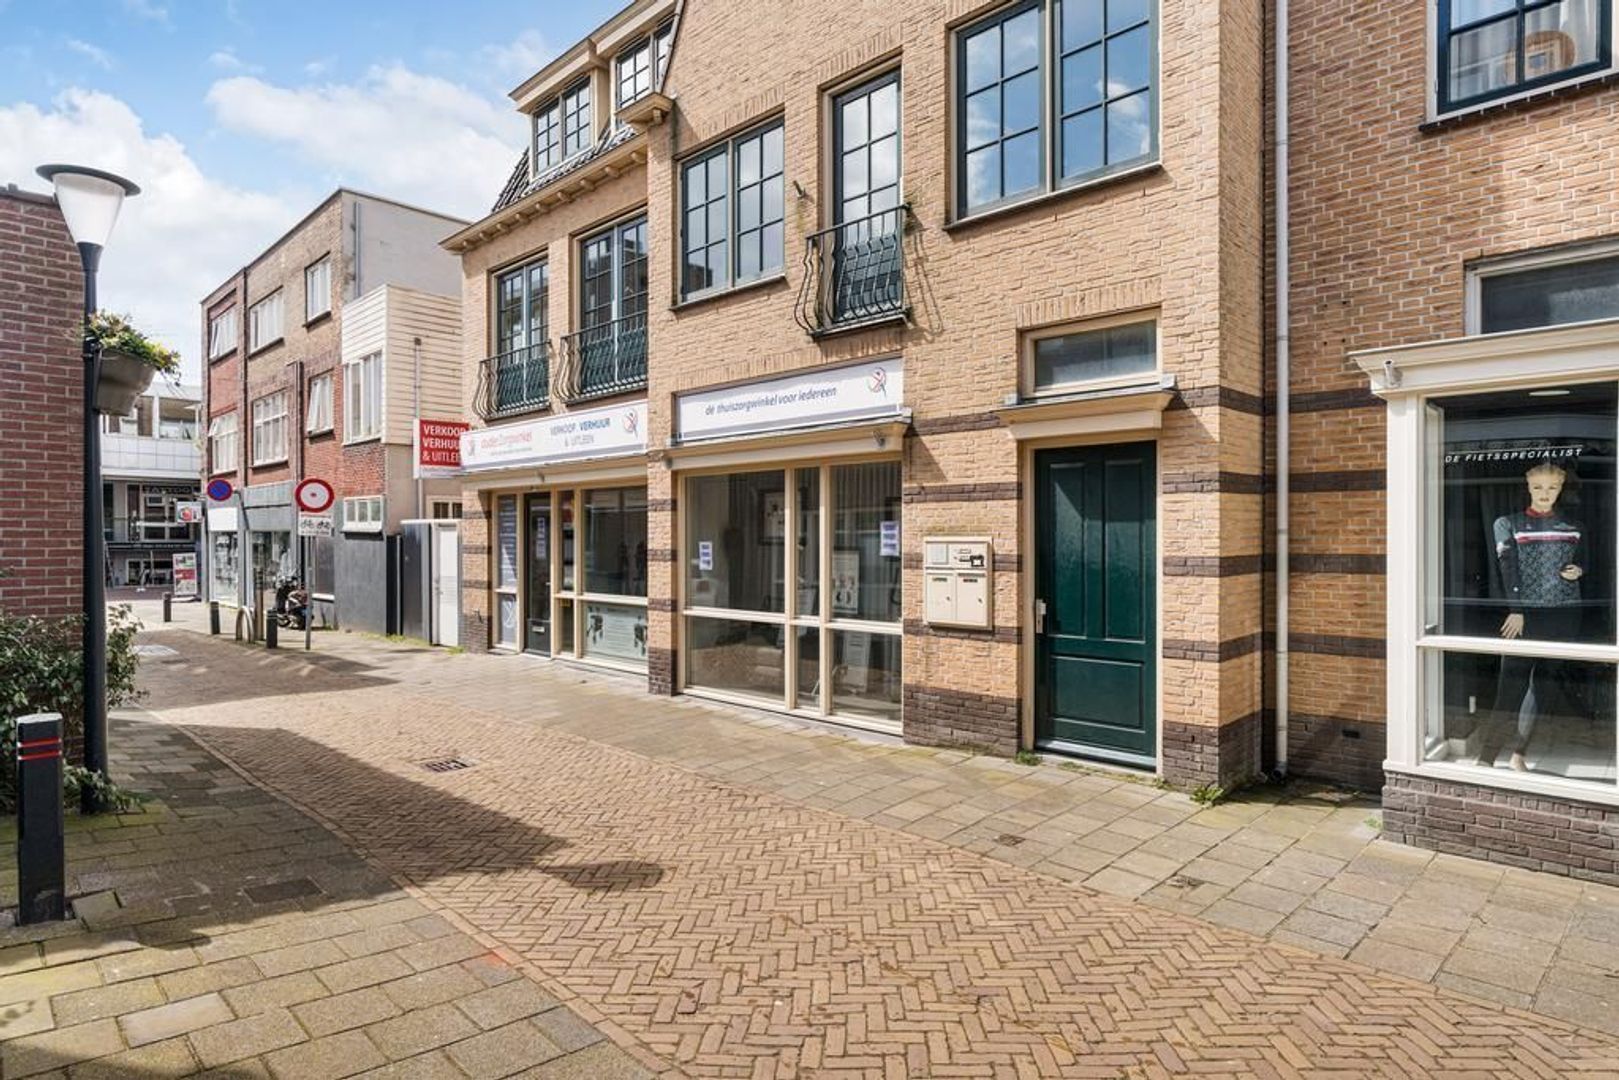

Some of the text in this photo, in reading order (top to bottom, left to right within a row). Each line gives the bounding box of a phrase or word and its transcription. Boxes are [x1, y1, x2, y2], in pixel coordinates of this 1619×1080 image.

[705, 386, 837, 416] de thuiszorgwinkel voor iedereen
[580, 418, 610, 431] VERHUUR
[422, 437, 460, 449] VERHUU
[422, 450, 431, 462] &
[1445, 448, 1582, 463] DE FIETSSPECIALIST
